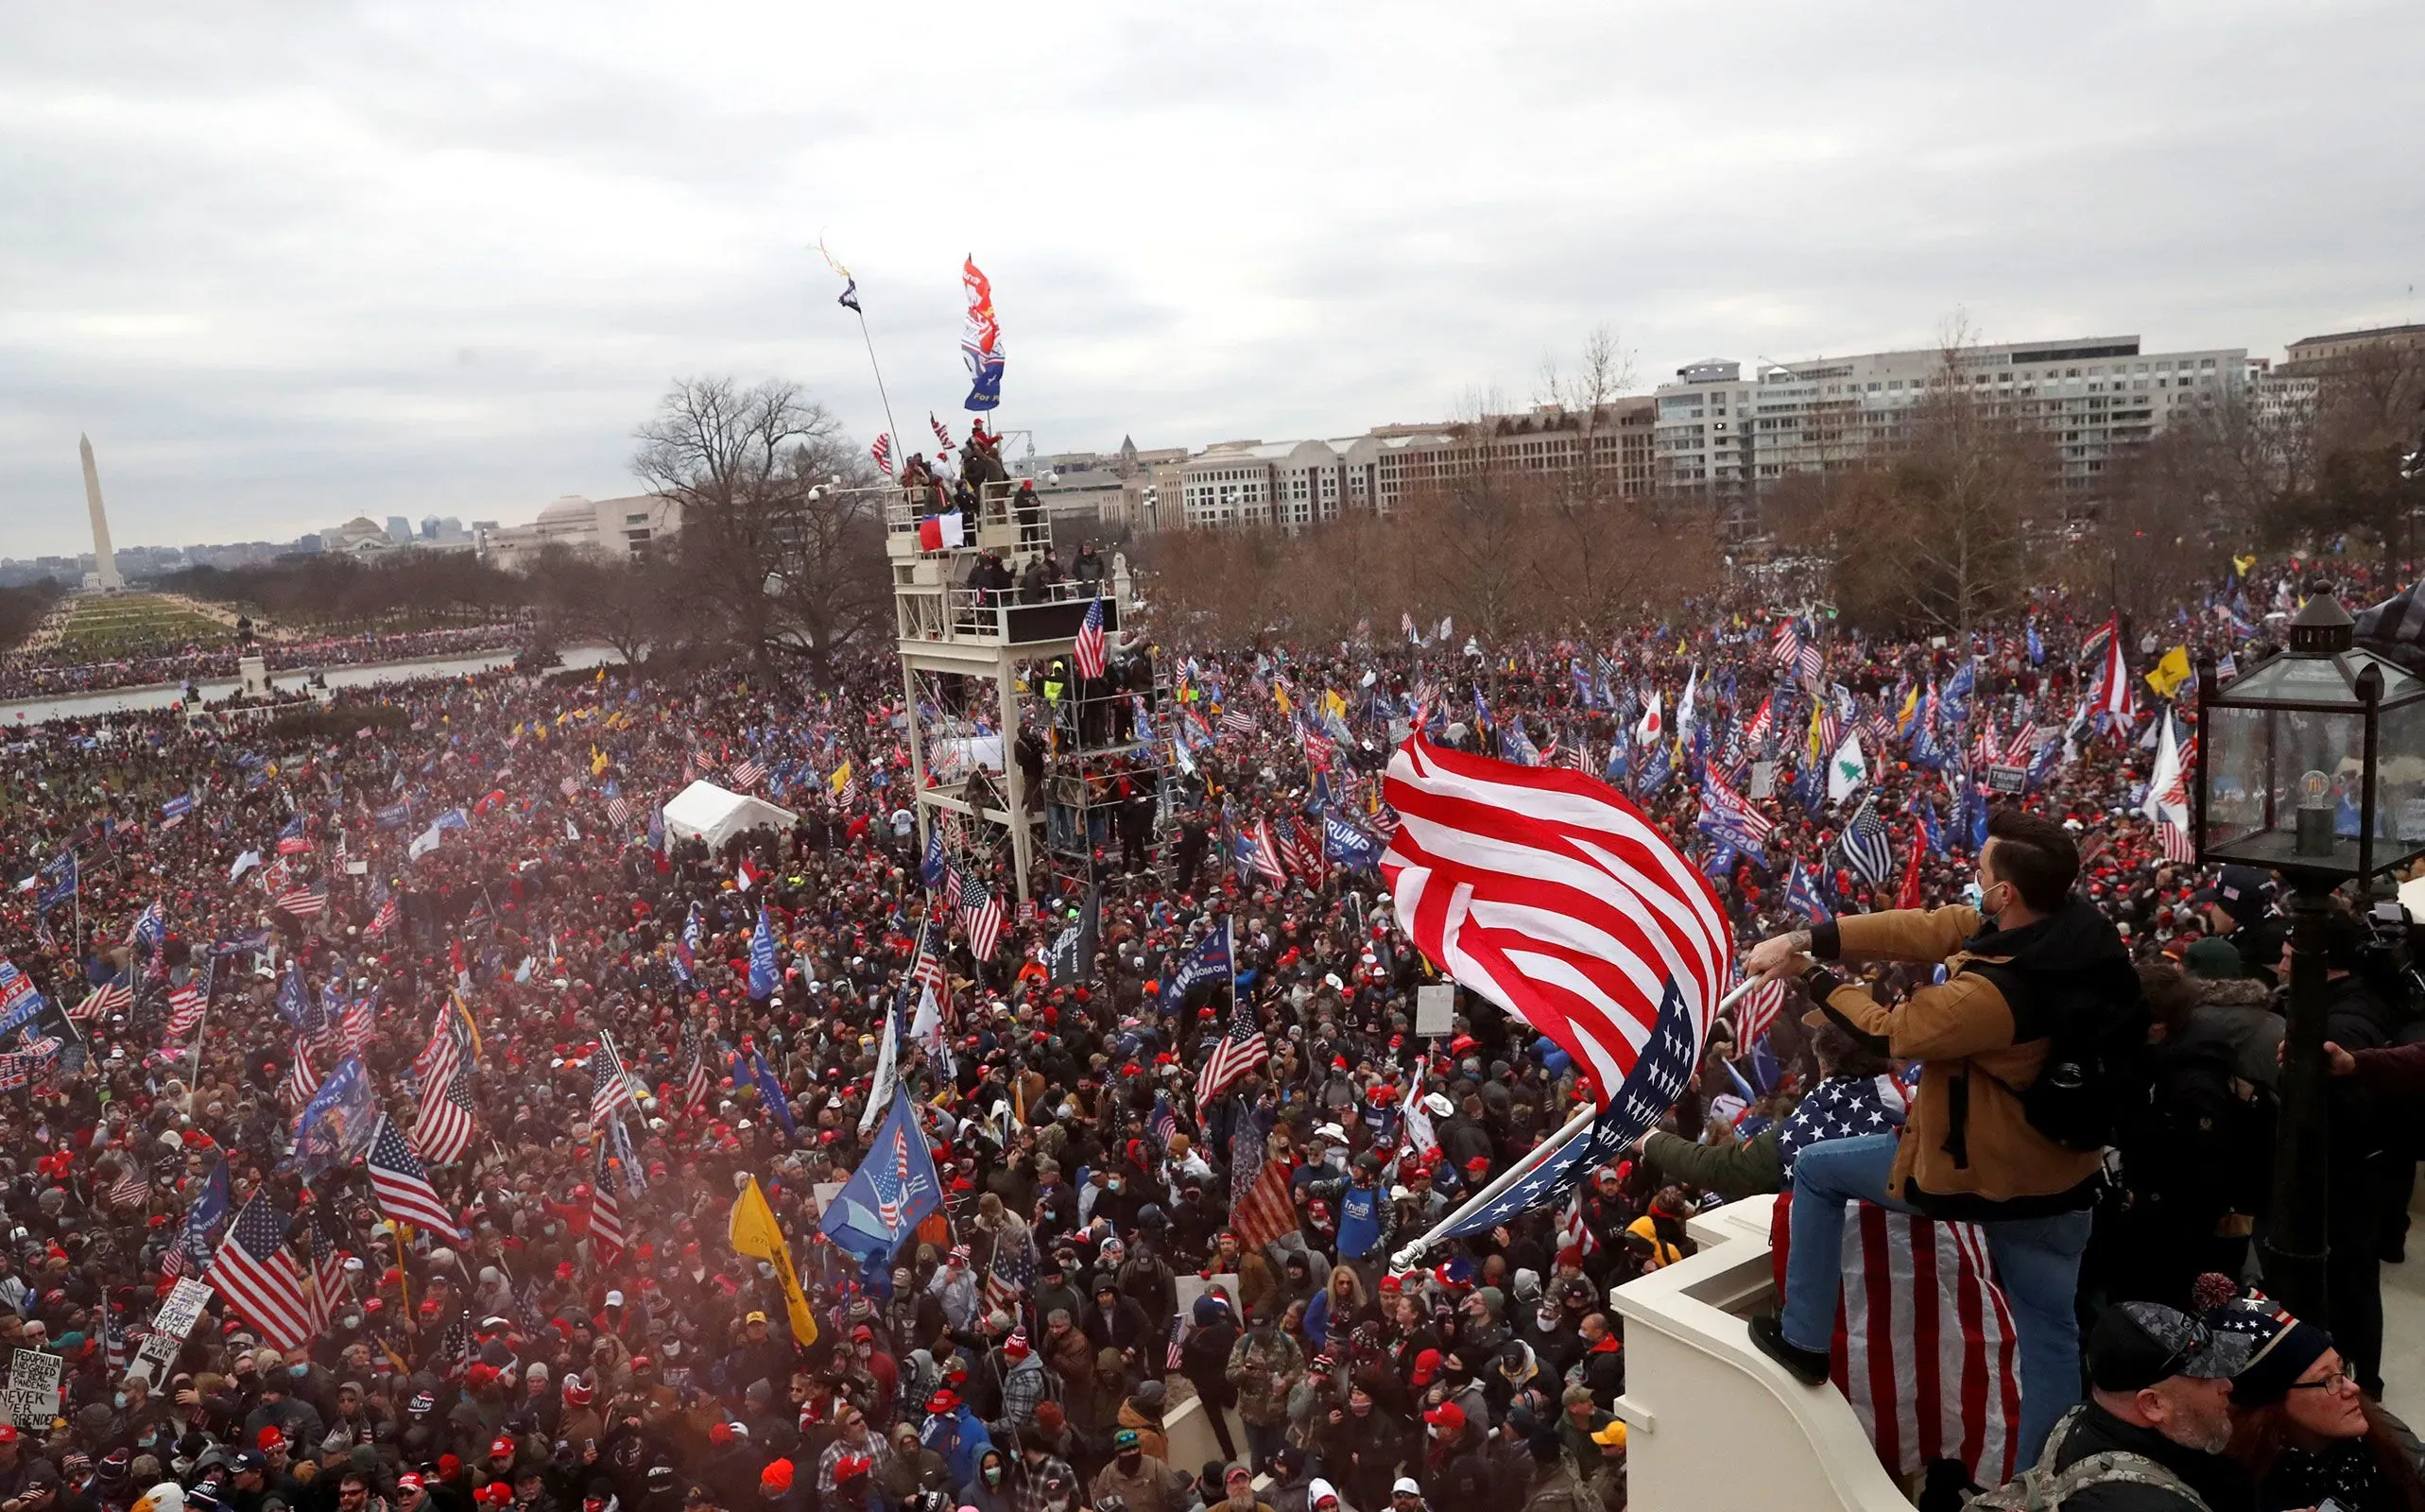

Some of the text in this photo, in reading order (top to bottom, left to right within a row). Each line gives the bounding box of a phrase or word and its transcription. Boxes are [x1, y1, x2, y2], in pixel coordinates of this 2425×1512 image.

[1711, 825, 1758, 853] 2020
[1345, 1198, 1369, 1216] Trump
[145, 1334, 181, 1352] FLORIDA
[15, 1349, 60, 1368] PEDOPHILIA
[146, 1346, 171, 1358] MAN
[13, 1362, 56, 1377] AND GREED
[27, 1372, 48, 1383] REAL
[13, 1377, 51, 1392] PANDEMIC
[0, 1390, 45, 1406] NEVER
